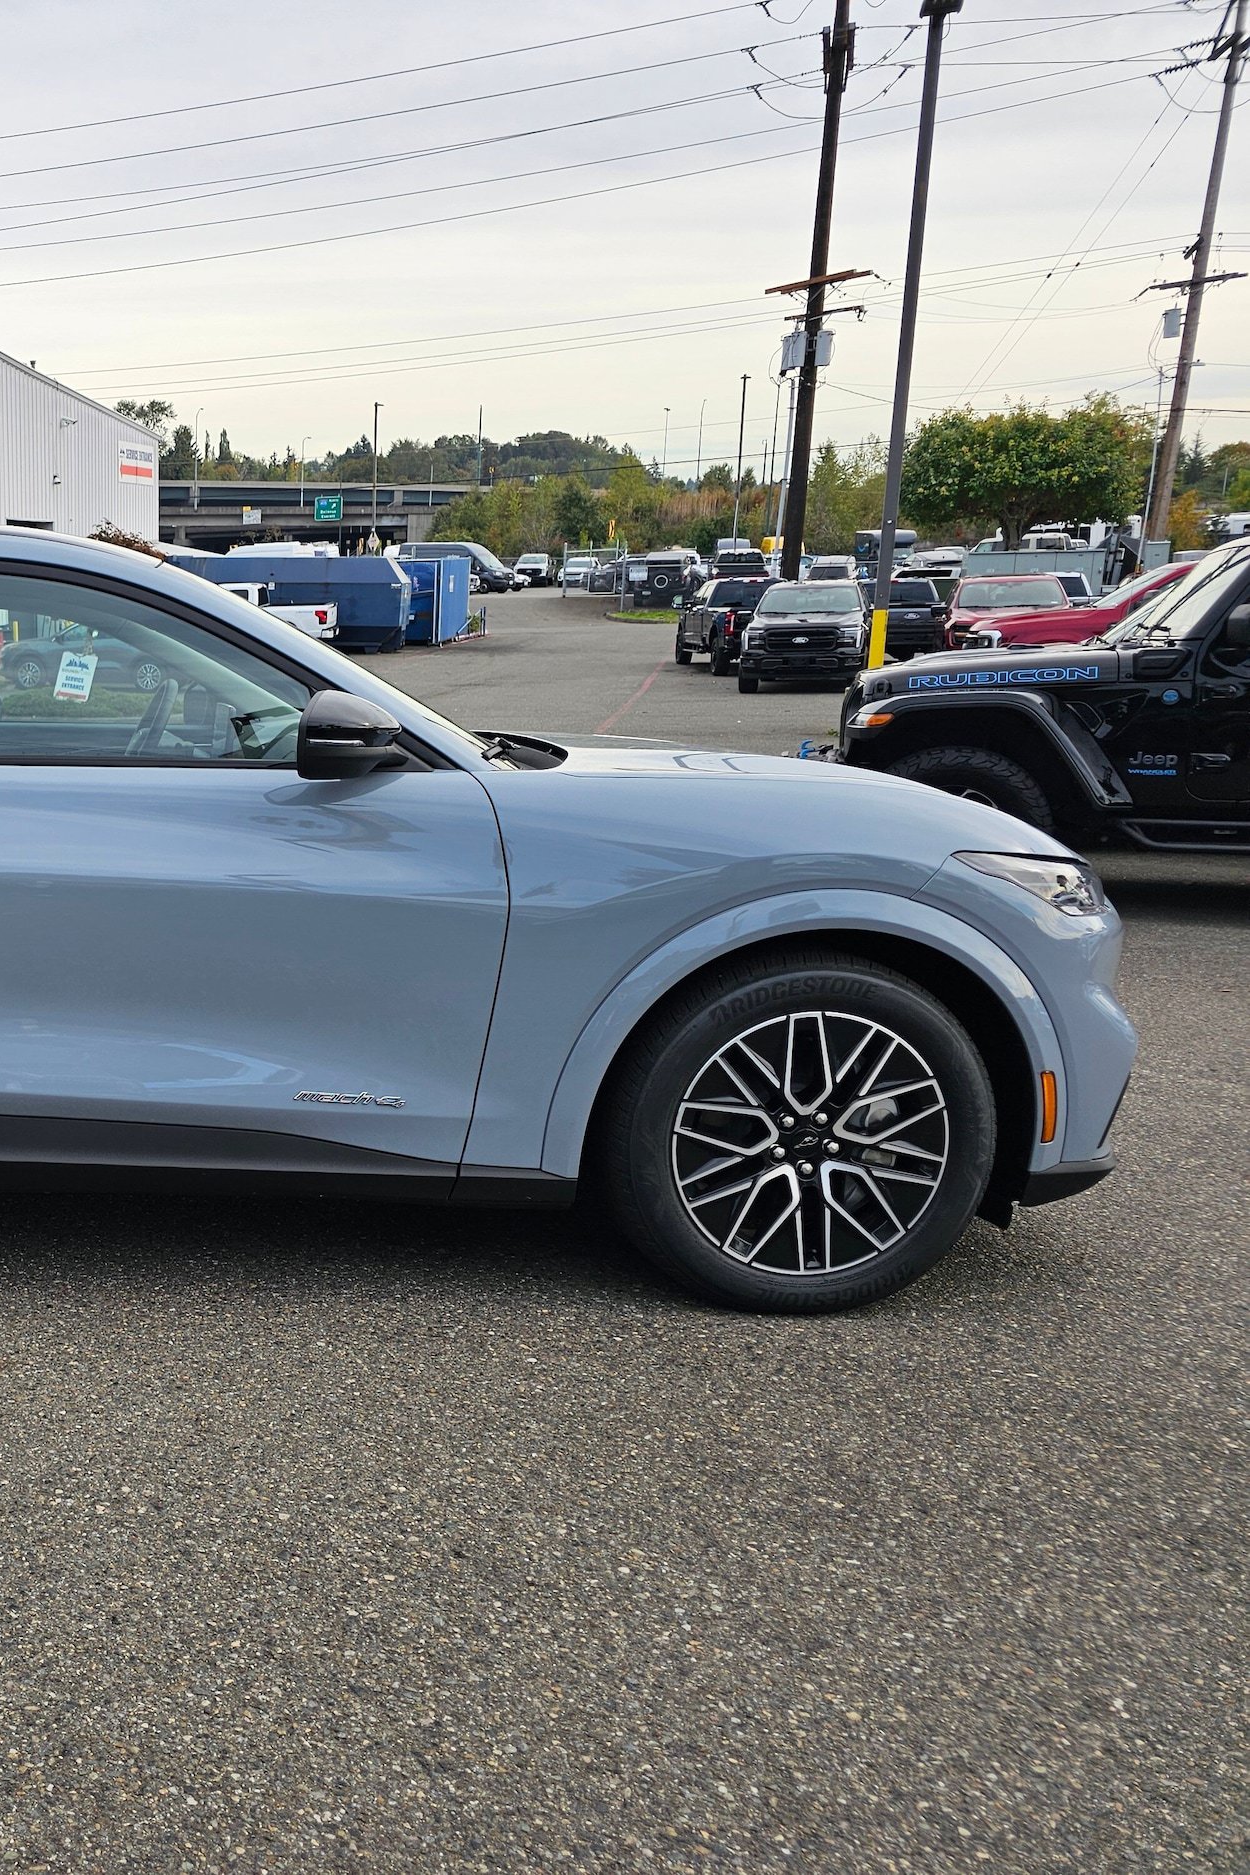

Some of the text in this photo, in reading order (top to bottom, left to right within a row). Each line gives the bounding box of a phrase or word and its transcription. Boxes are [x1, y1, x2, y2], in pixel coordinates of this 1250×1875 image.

[61, 682, 85, 691] ENTRANCE
[908, 666, 1099, 689] RUBICON
[1129, 751, 1178, 768] Jeep
[707, 974, 880, 1026] BRIDGESTONE
